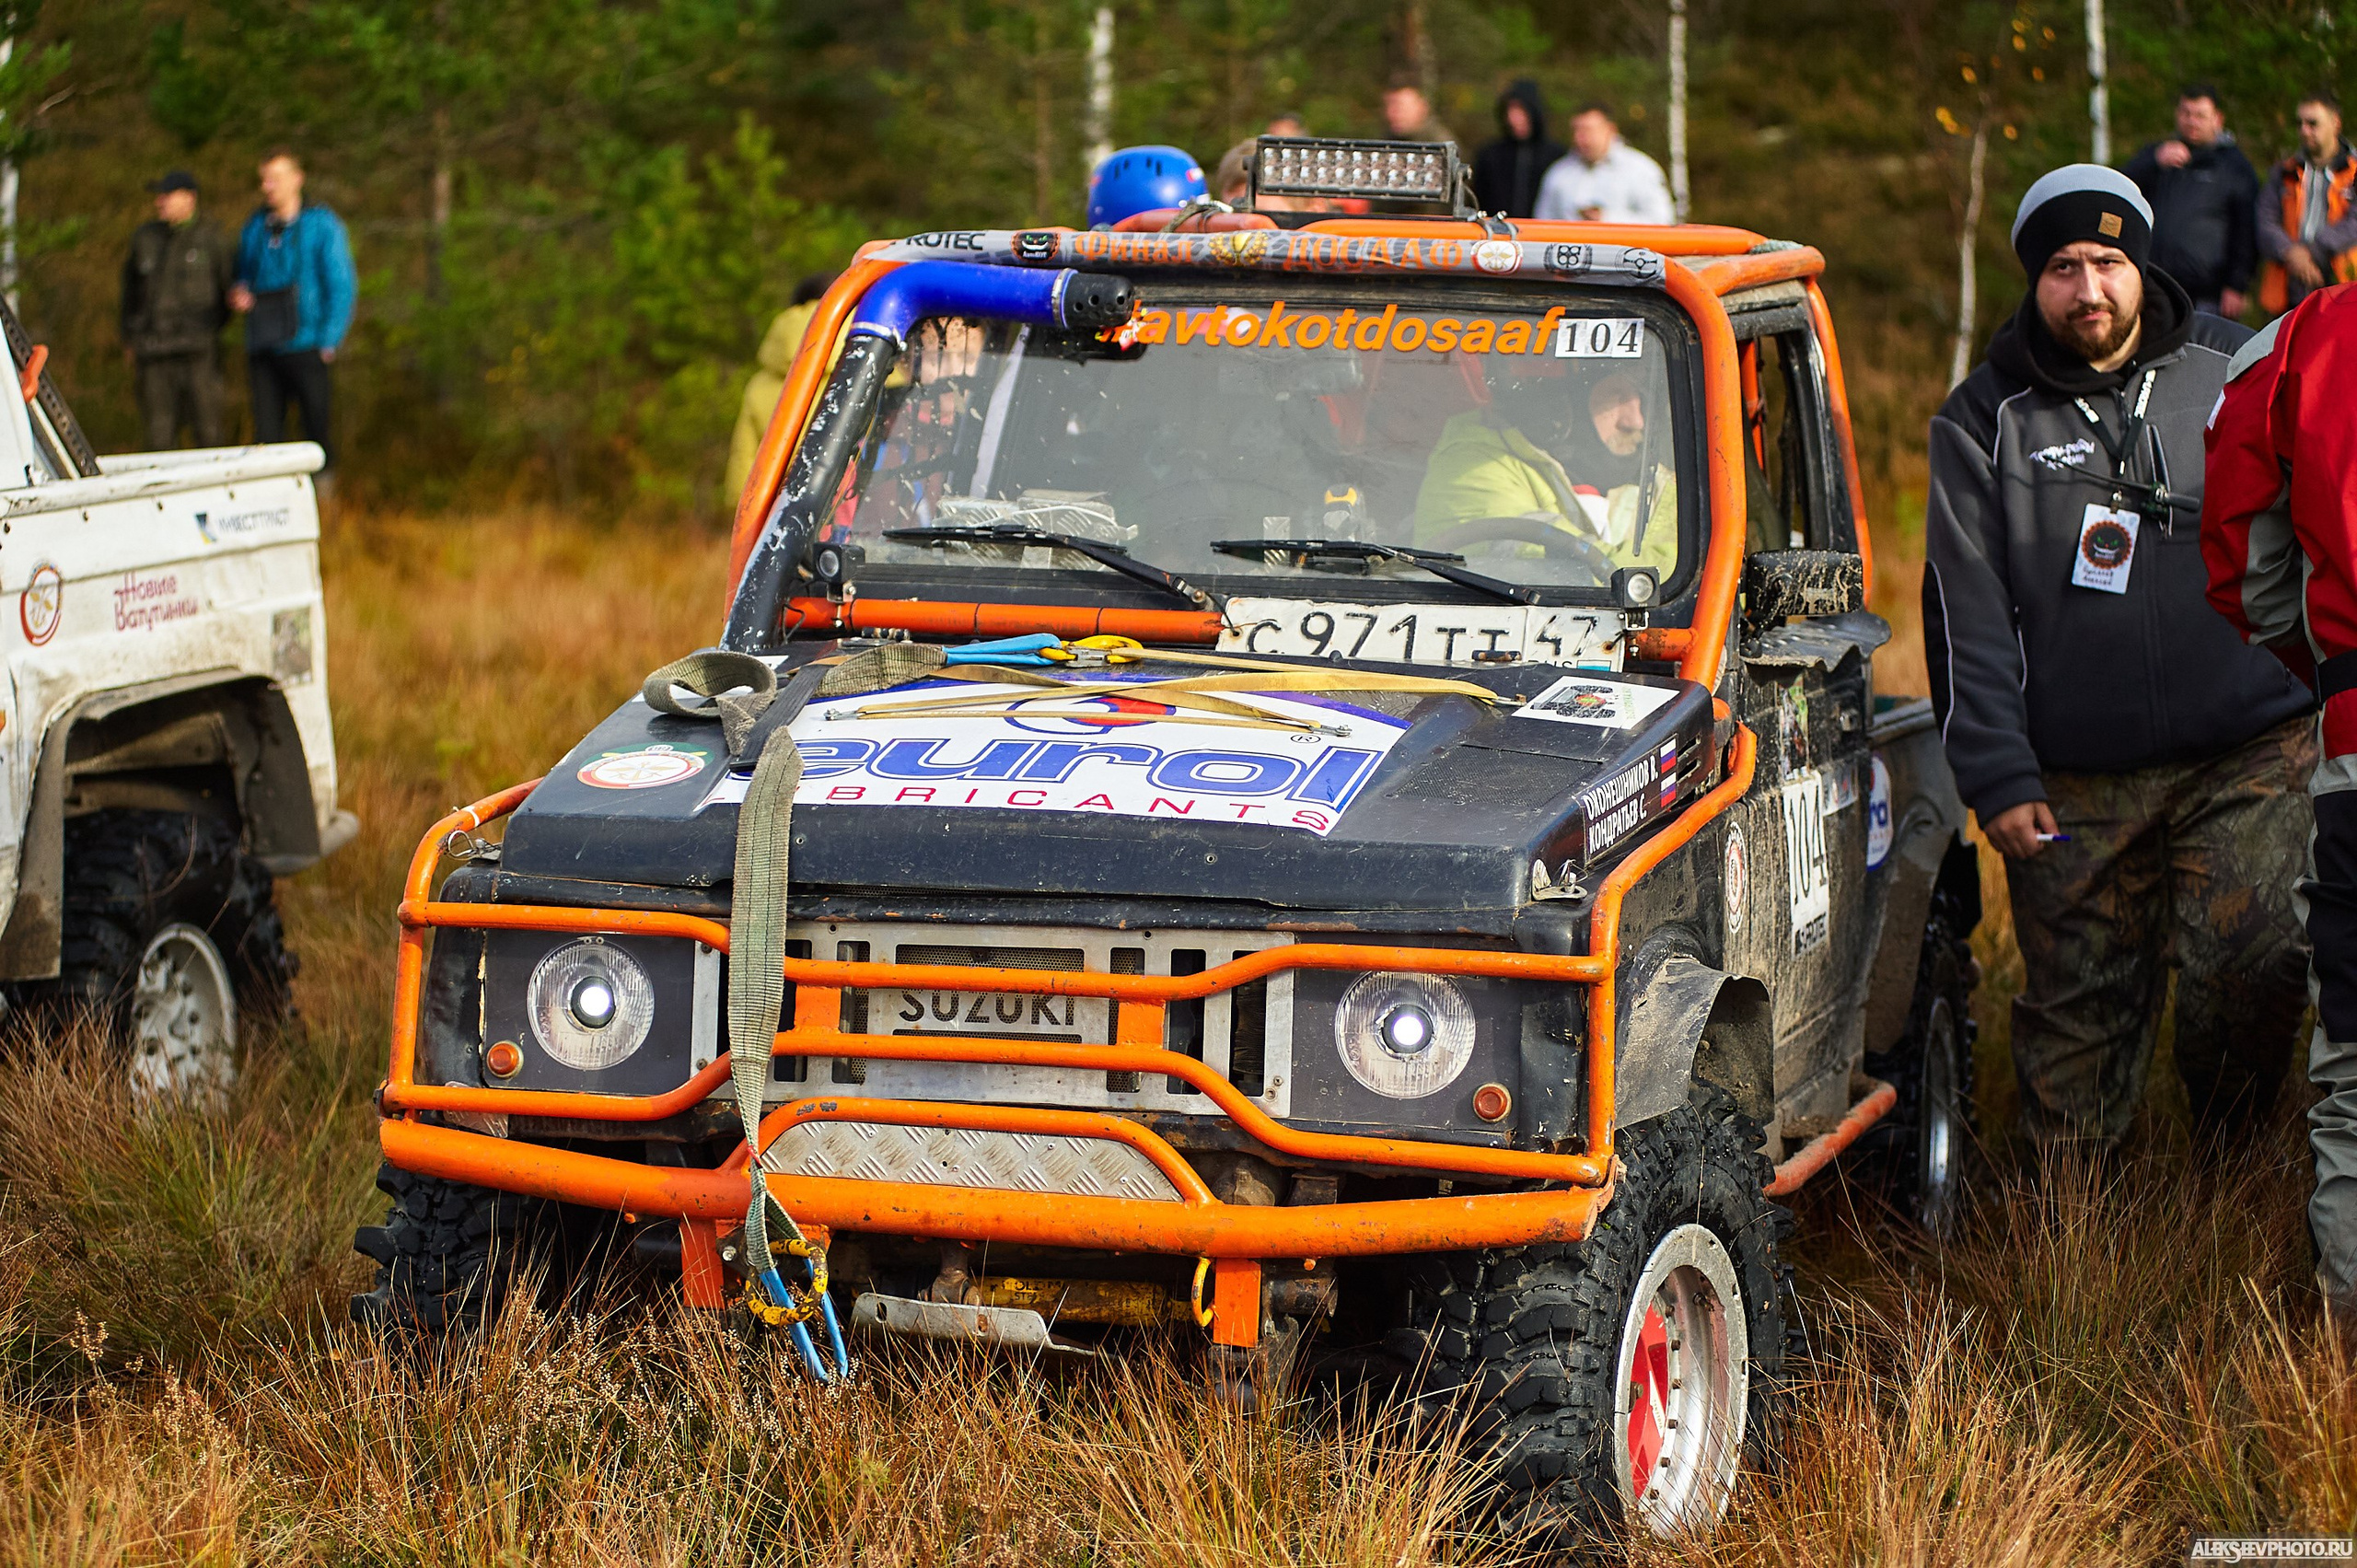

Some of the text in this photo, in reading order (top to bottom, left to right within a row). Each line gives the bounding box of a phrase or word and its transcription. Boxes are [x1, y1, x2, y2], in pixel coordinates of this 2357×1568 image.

[1074, 231, 1464, 273] Финал ДОСААФ
[1565, 322, 1639, 354] 104
[730, 737, 1385, 814] eurol
[1589, 798, 1639, 854] КОНДРАТЬЕВ
[1789, 784, 1827, 906] 104
[899, 990, 1074, 1026] SUZUKI
